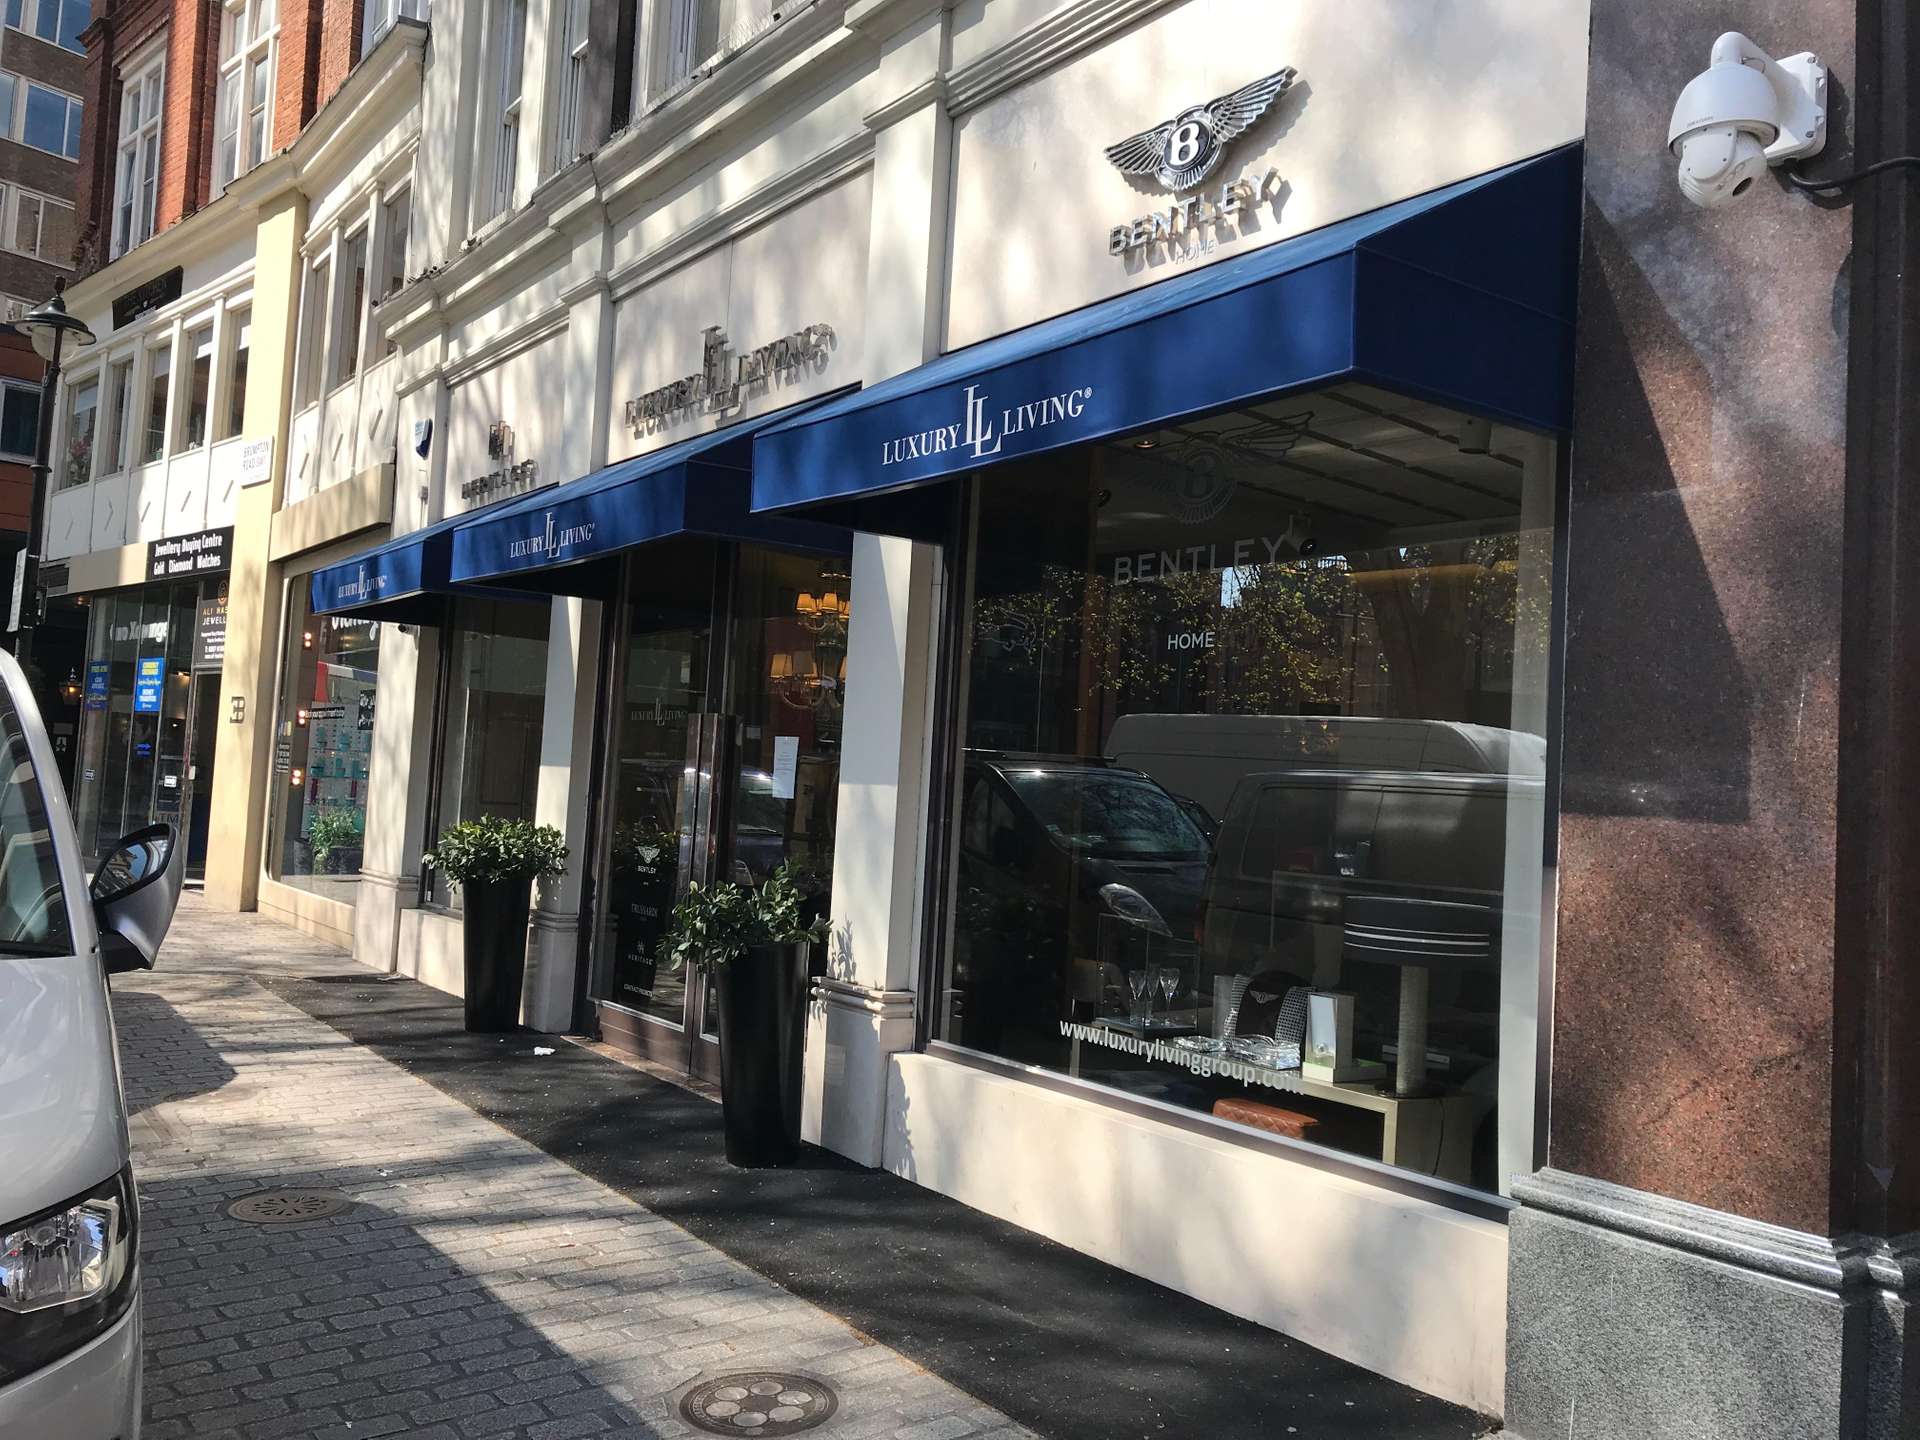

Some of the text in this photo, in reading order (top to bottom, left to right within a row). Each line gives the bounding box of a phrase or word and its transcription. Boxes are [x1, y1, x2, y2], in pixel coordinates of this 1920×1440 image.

[1108, 167, 1279, 257] BENTLEY
[1175, 240, 1216, 264] HOME
[882, 423, 961, 466] LUXURY
[154, 532, 223, 558] Jewellery Buying Centre
[510, 535, 545, 559] LUXURY
[153, 552, 221, 576] Gold Diamond Watches
[1113, 534, 1287, 587] BENTLEY
[1166, 630, 1216, 650] HOME
